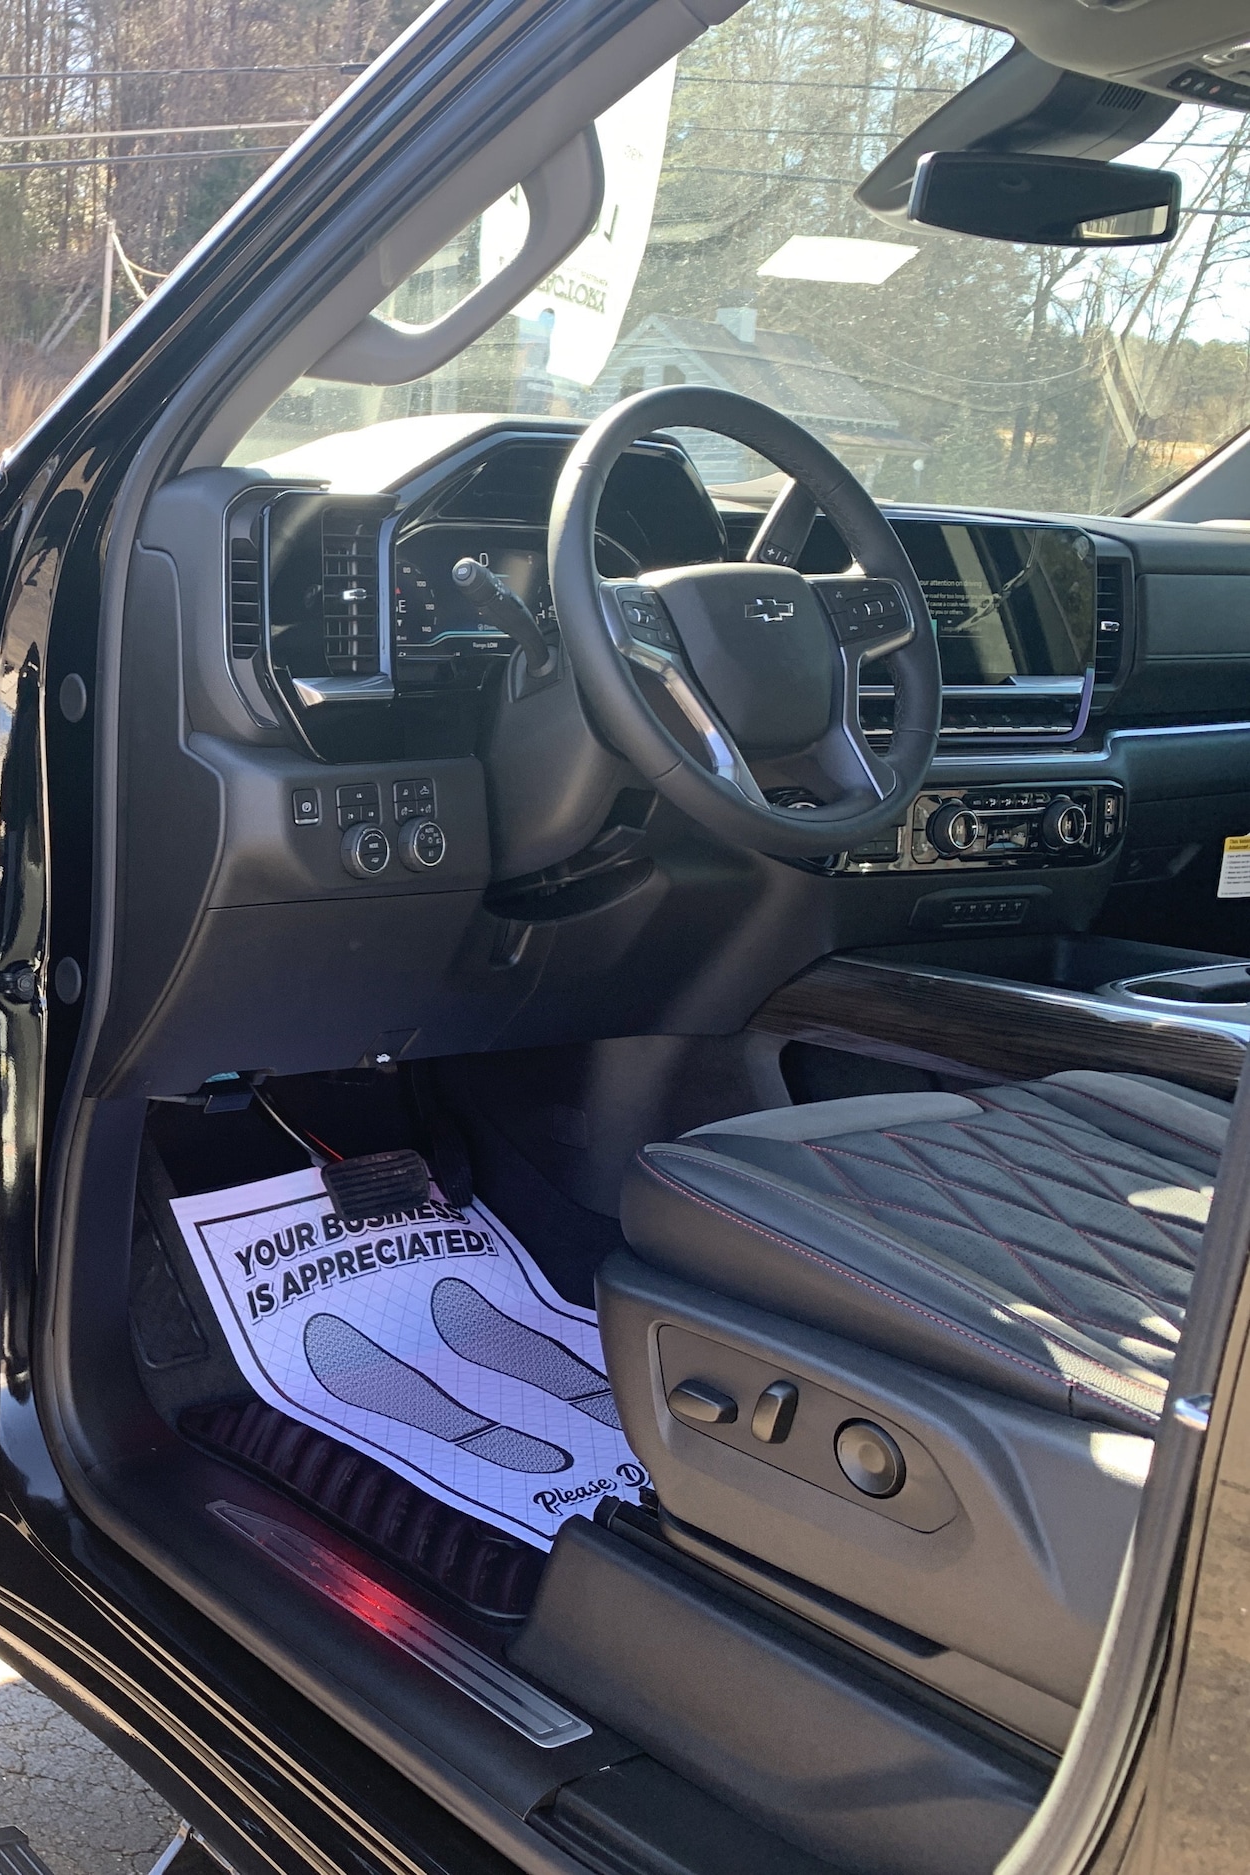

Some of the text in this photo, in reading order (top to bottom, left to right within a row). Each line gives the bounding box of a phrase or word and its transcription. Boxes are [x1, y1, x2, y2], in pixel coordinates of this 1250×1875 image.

[234, 1221, 319, 1278] YOUR
[246, 1229, 496, 1321] IS APPRECIATED!
[532, 1478, 617, 1516] Please
